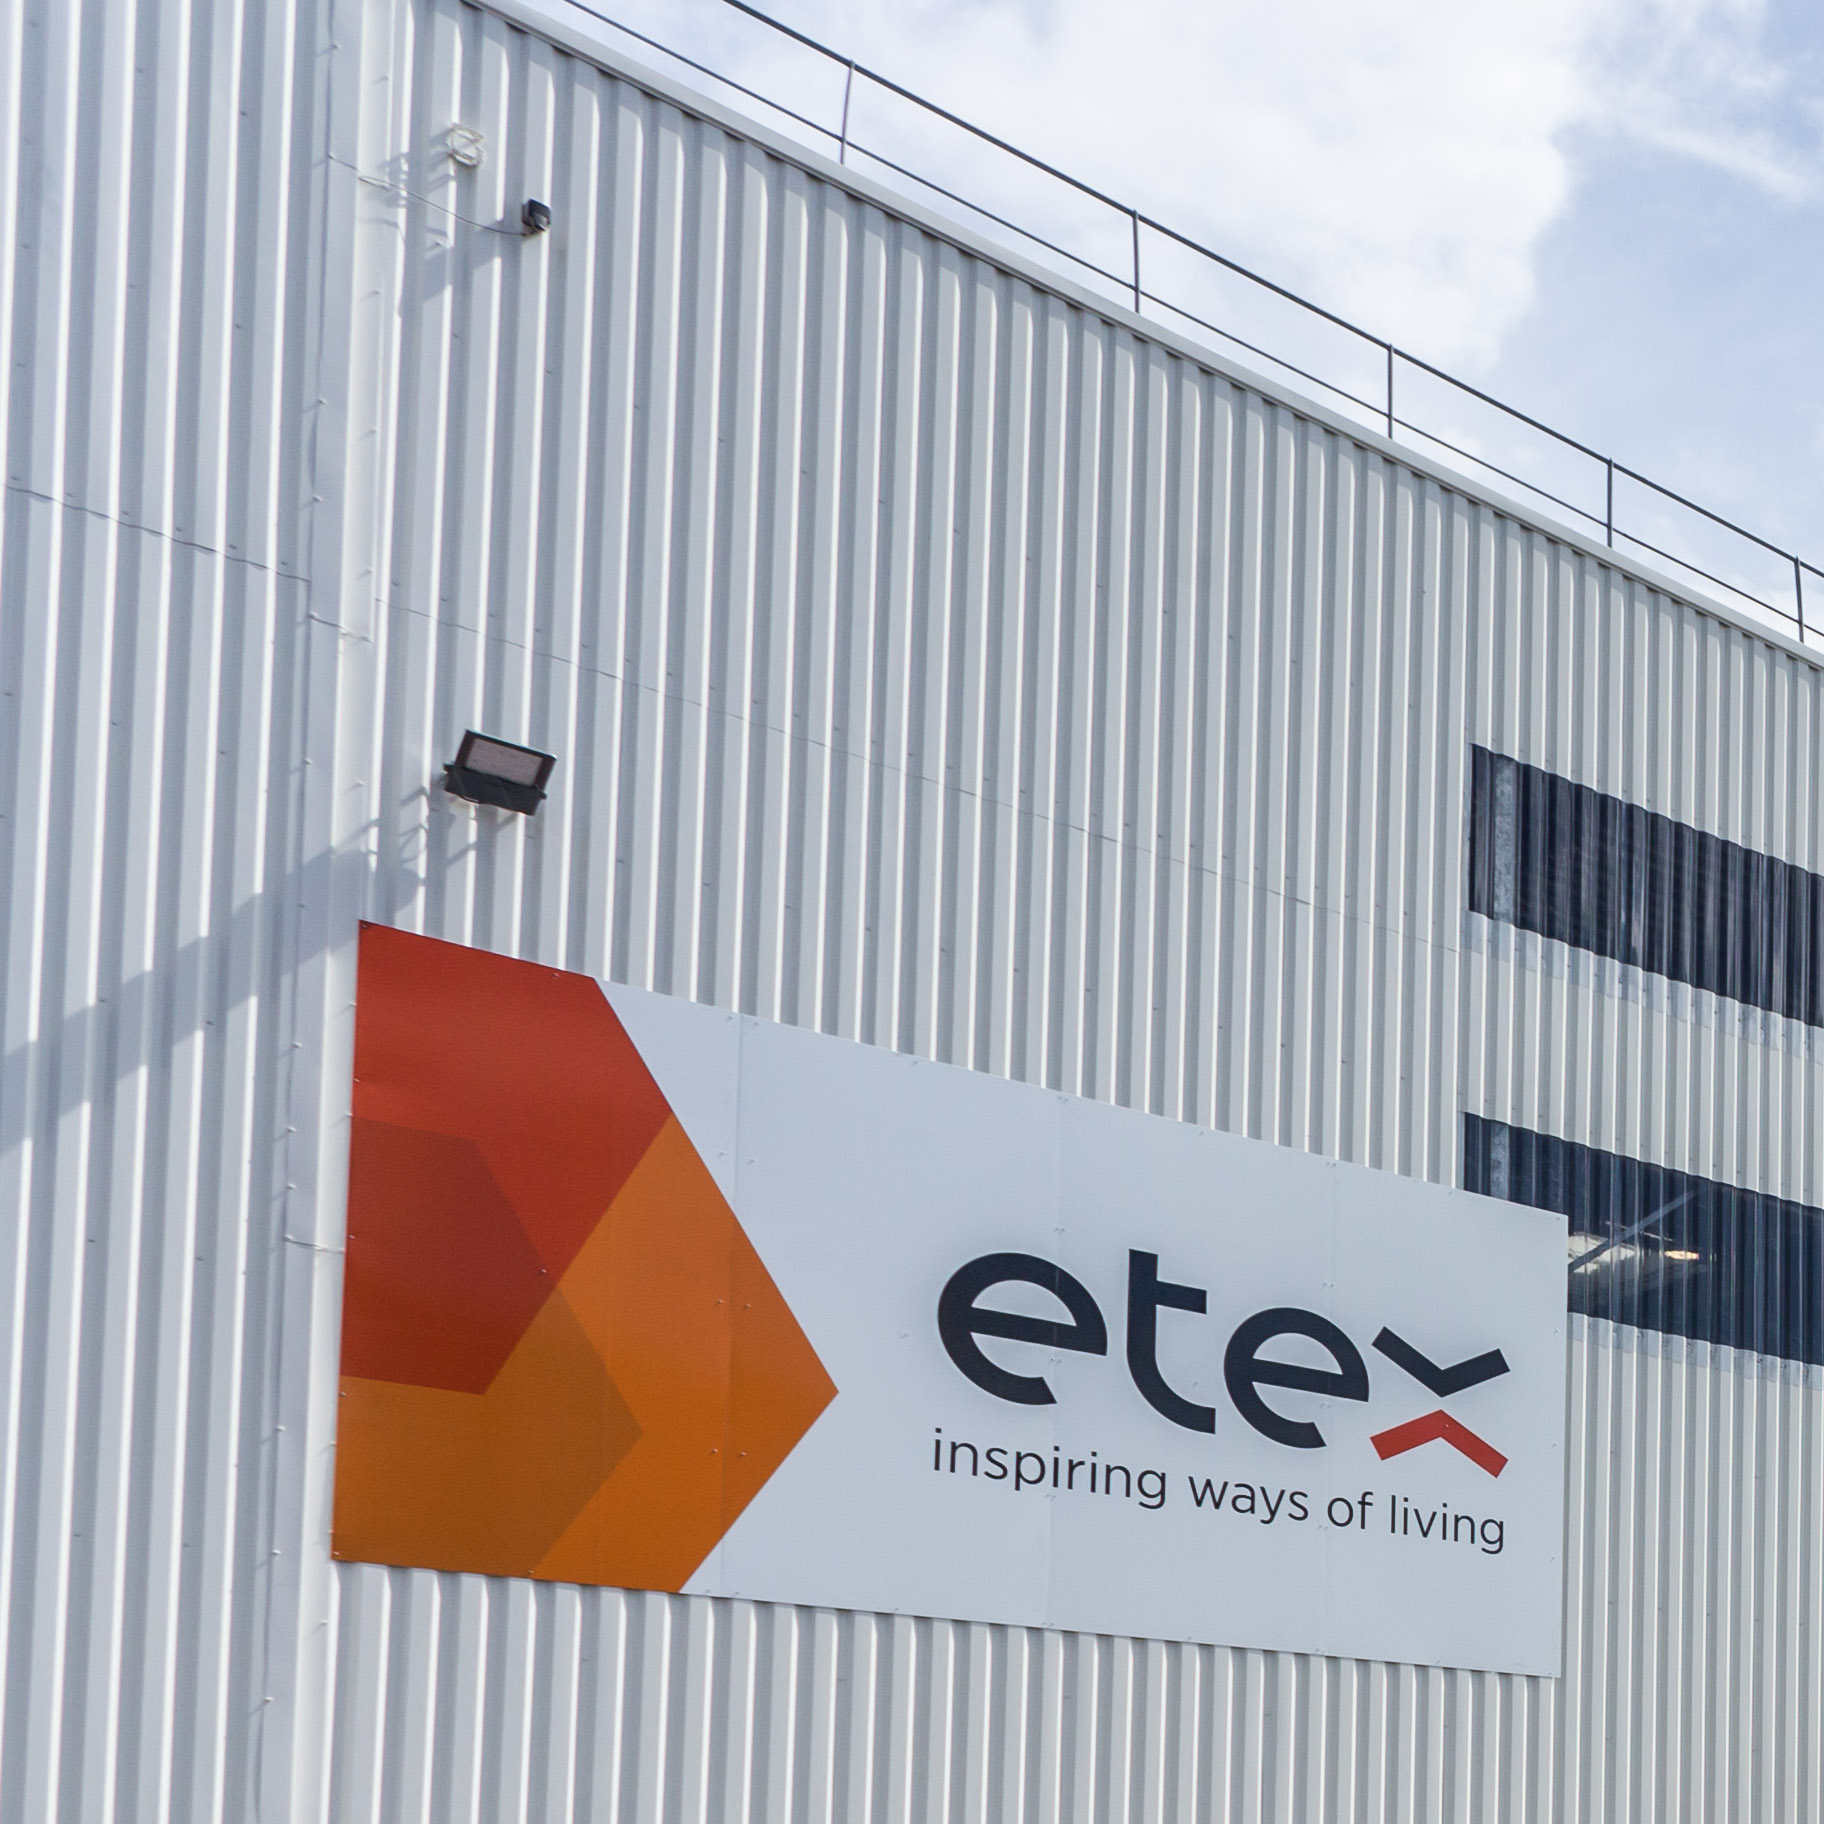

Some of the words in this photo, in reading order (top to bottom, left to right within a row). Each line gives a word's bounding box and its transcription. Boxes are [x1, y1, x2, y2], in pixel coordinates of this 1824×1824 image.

[937, 1248, 1511, 1479] etex
[933, 1427, 1168, 1510] inspiring
[1188, 1475, 1310, 1525] ways
[1326, 1491, 1374, 1530] of
[1390, 1495, 1505, 1555] living
